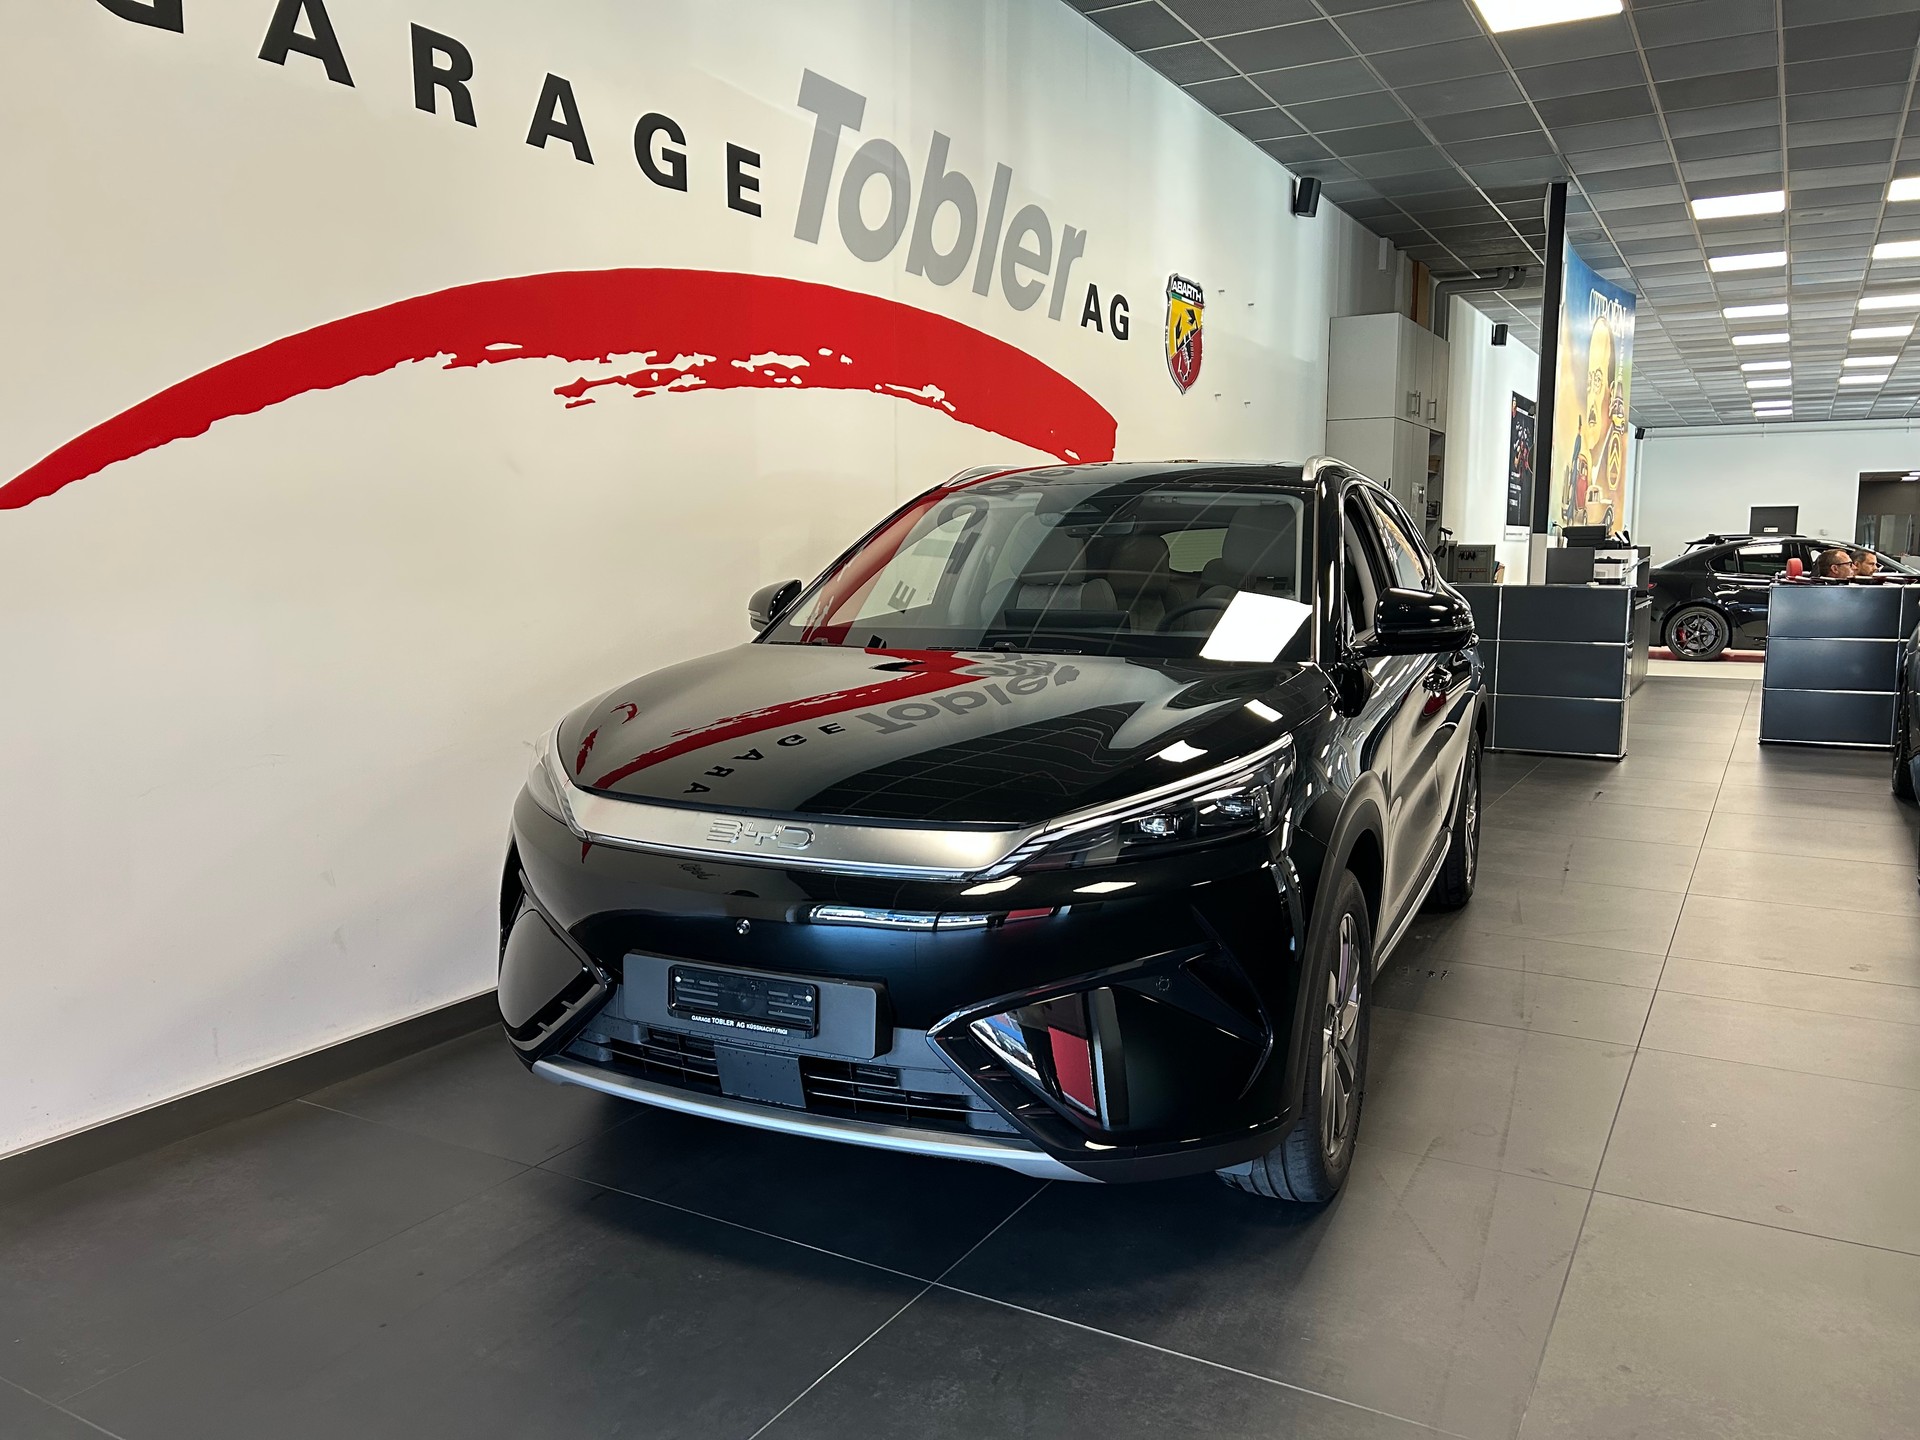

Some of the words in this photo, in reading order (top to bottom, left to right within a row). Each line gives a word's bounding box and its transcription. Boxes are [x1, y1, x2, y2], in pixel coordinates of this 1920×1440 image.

[794, 68, 1087, 322] Tobler
[1081, 282, 1130, 341] AG
[1172, 280, 1202, 302] ABARTH
[706, 817, 816, 851] BYD
[691, 1014, 711, 1023] GARAGE
[712, 1017, 735, 1027] TOBLER
[736, 1021, 746, 1029] AG
